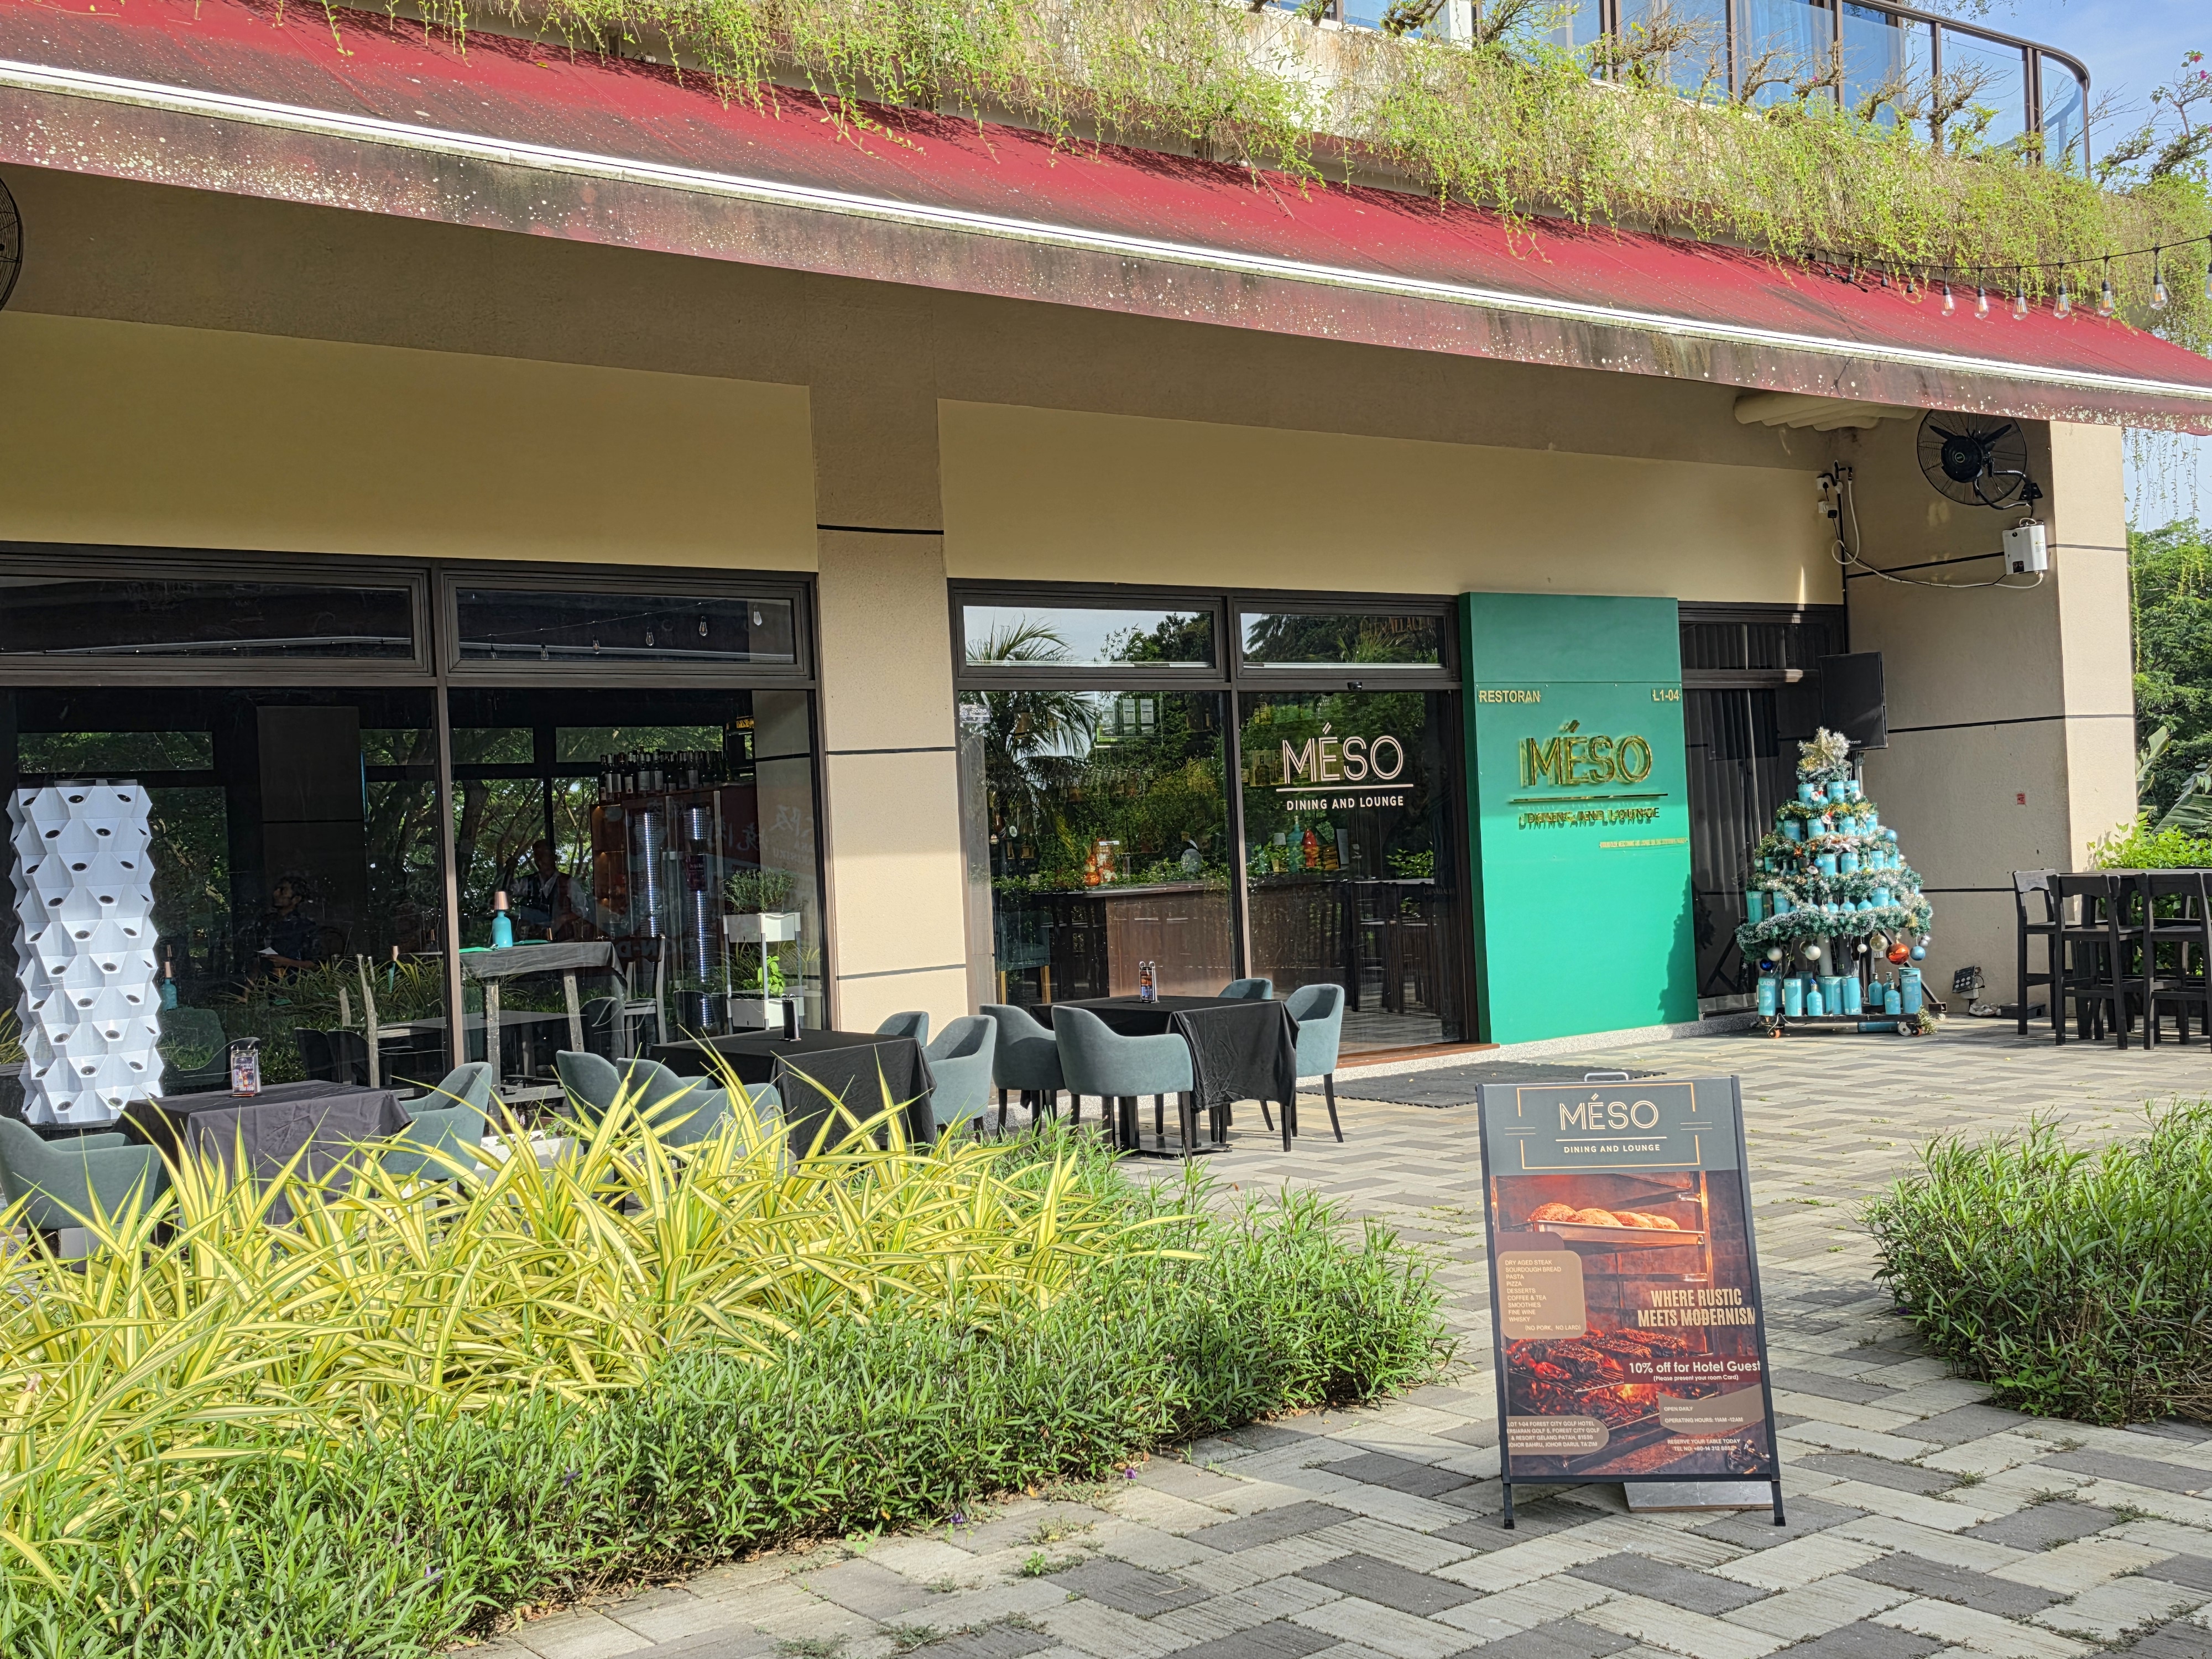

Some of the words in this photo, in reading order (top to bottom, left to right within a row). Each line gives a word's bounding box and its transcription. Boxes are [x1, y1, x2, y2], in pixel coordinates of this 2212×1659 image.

[1479, 690, 1540, 702] RESTORAN
[1653, 690, 1679, 701] L1-04
[1282, 722, 1403, 784] MÉSO
[1521, 719, 1652, 786] MÉSO
[1287, 799, 1327, 810] DINING
[1332, 797, 1355, 808] AND
[1360, 796, 1404, 807] LOUNGE
[1559, 1093, 1658, 1130] MÉSO
[1651, 1290, 1695, 1307] WHERE
[1698, 1288, 1741, 1306] RUSTIC
[1638, 1310, 1678, 1327] MEETS
[1629, 1363, 1653, 1373] 10%
[1656, 1362, 1671, 1373] off
[1674, 1361, 1689, 1373] for
[1693, 1361, 1723, 1372] Hotel
[1727, 1360, 1760, 1371] Guest
